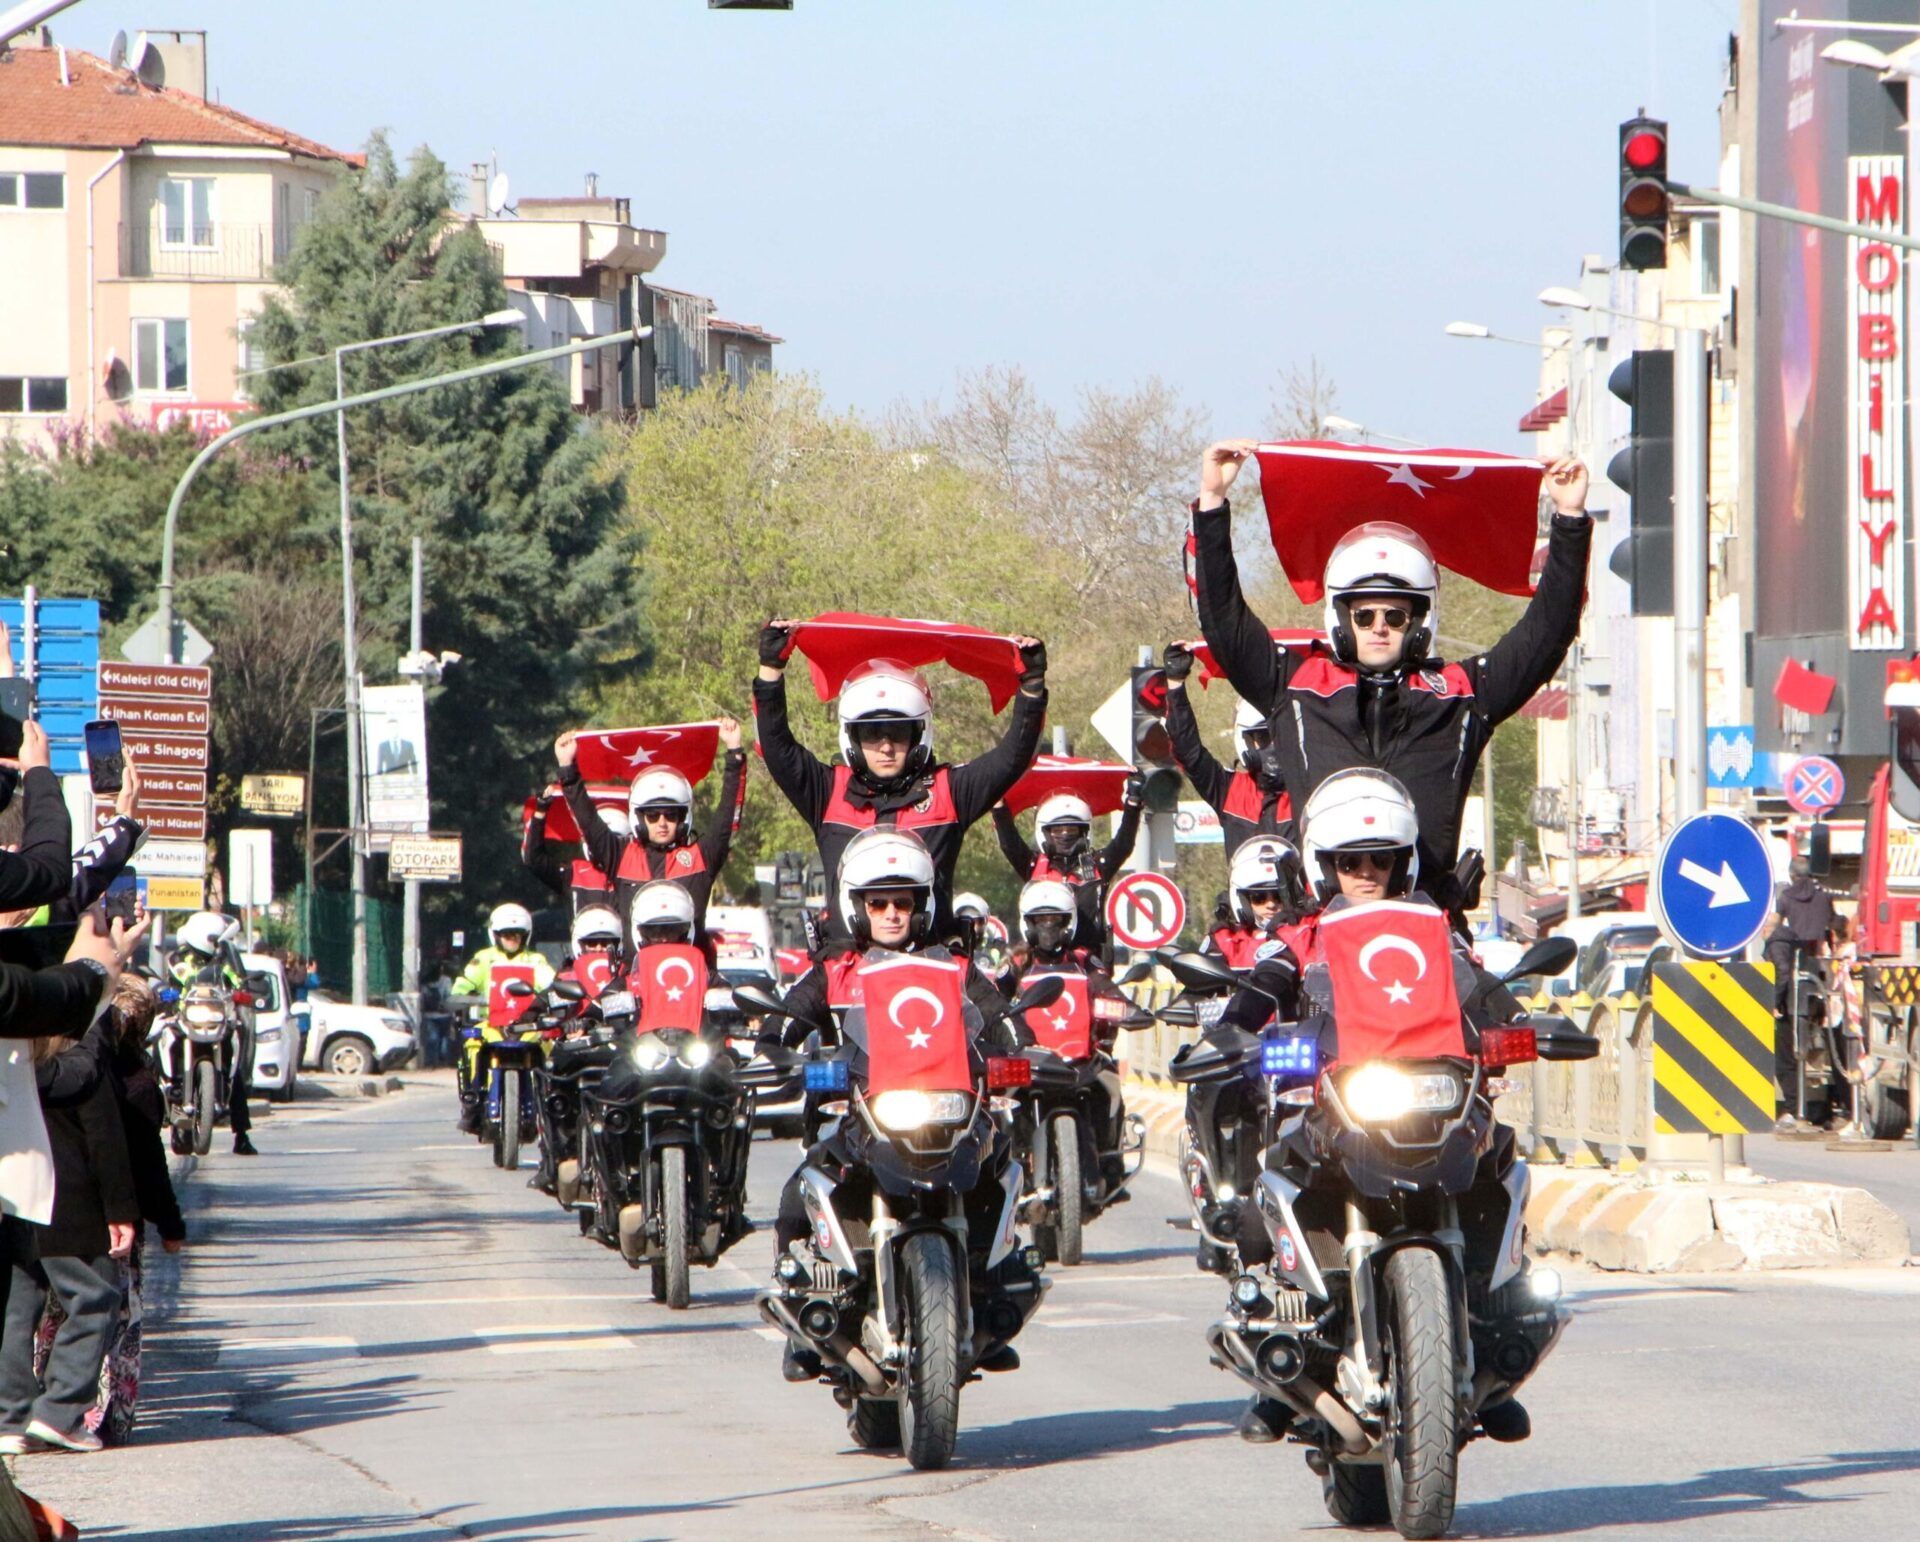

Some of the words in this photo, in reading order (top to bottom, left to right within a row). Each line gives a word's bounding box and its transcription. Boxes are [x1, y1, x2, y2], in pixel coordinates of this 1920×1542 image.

[112, 672, 152, 686] Kaleiçi
[154, 674, 178, 687] (Old
[180, 676, 208, 691] City)
[144, 709, 184, 722] Koman
[187, 712, 205, 723] Evi
[154, 744, 204, 760] Sinagog
[167, 818, 202, 829] Müzesi
[392, 853, 457, 866] OTOPARK
[149, 888, 201, 898] Yunanistan
